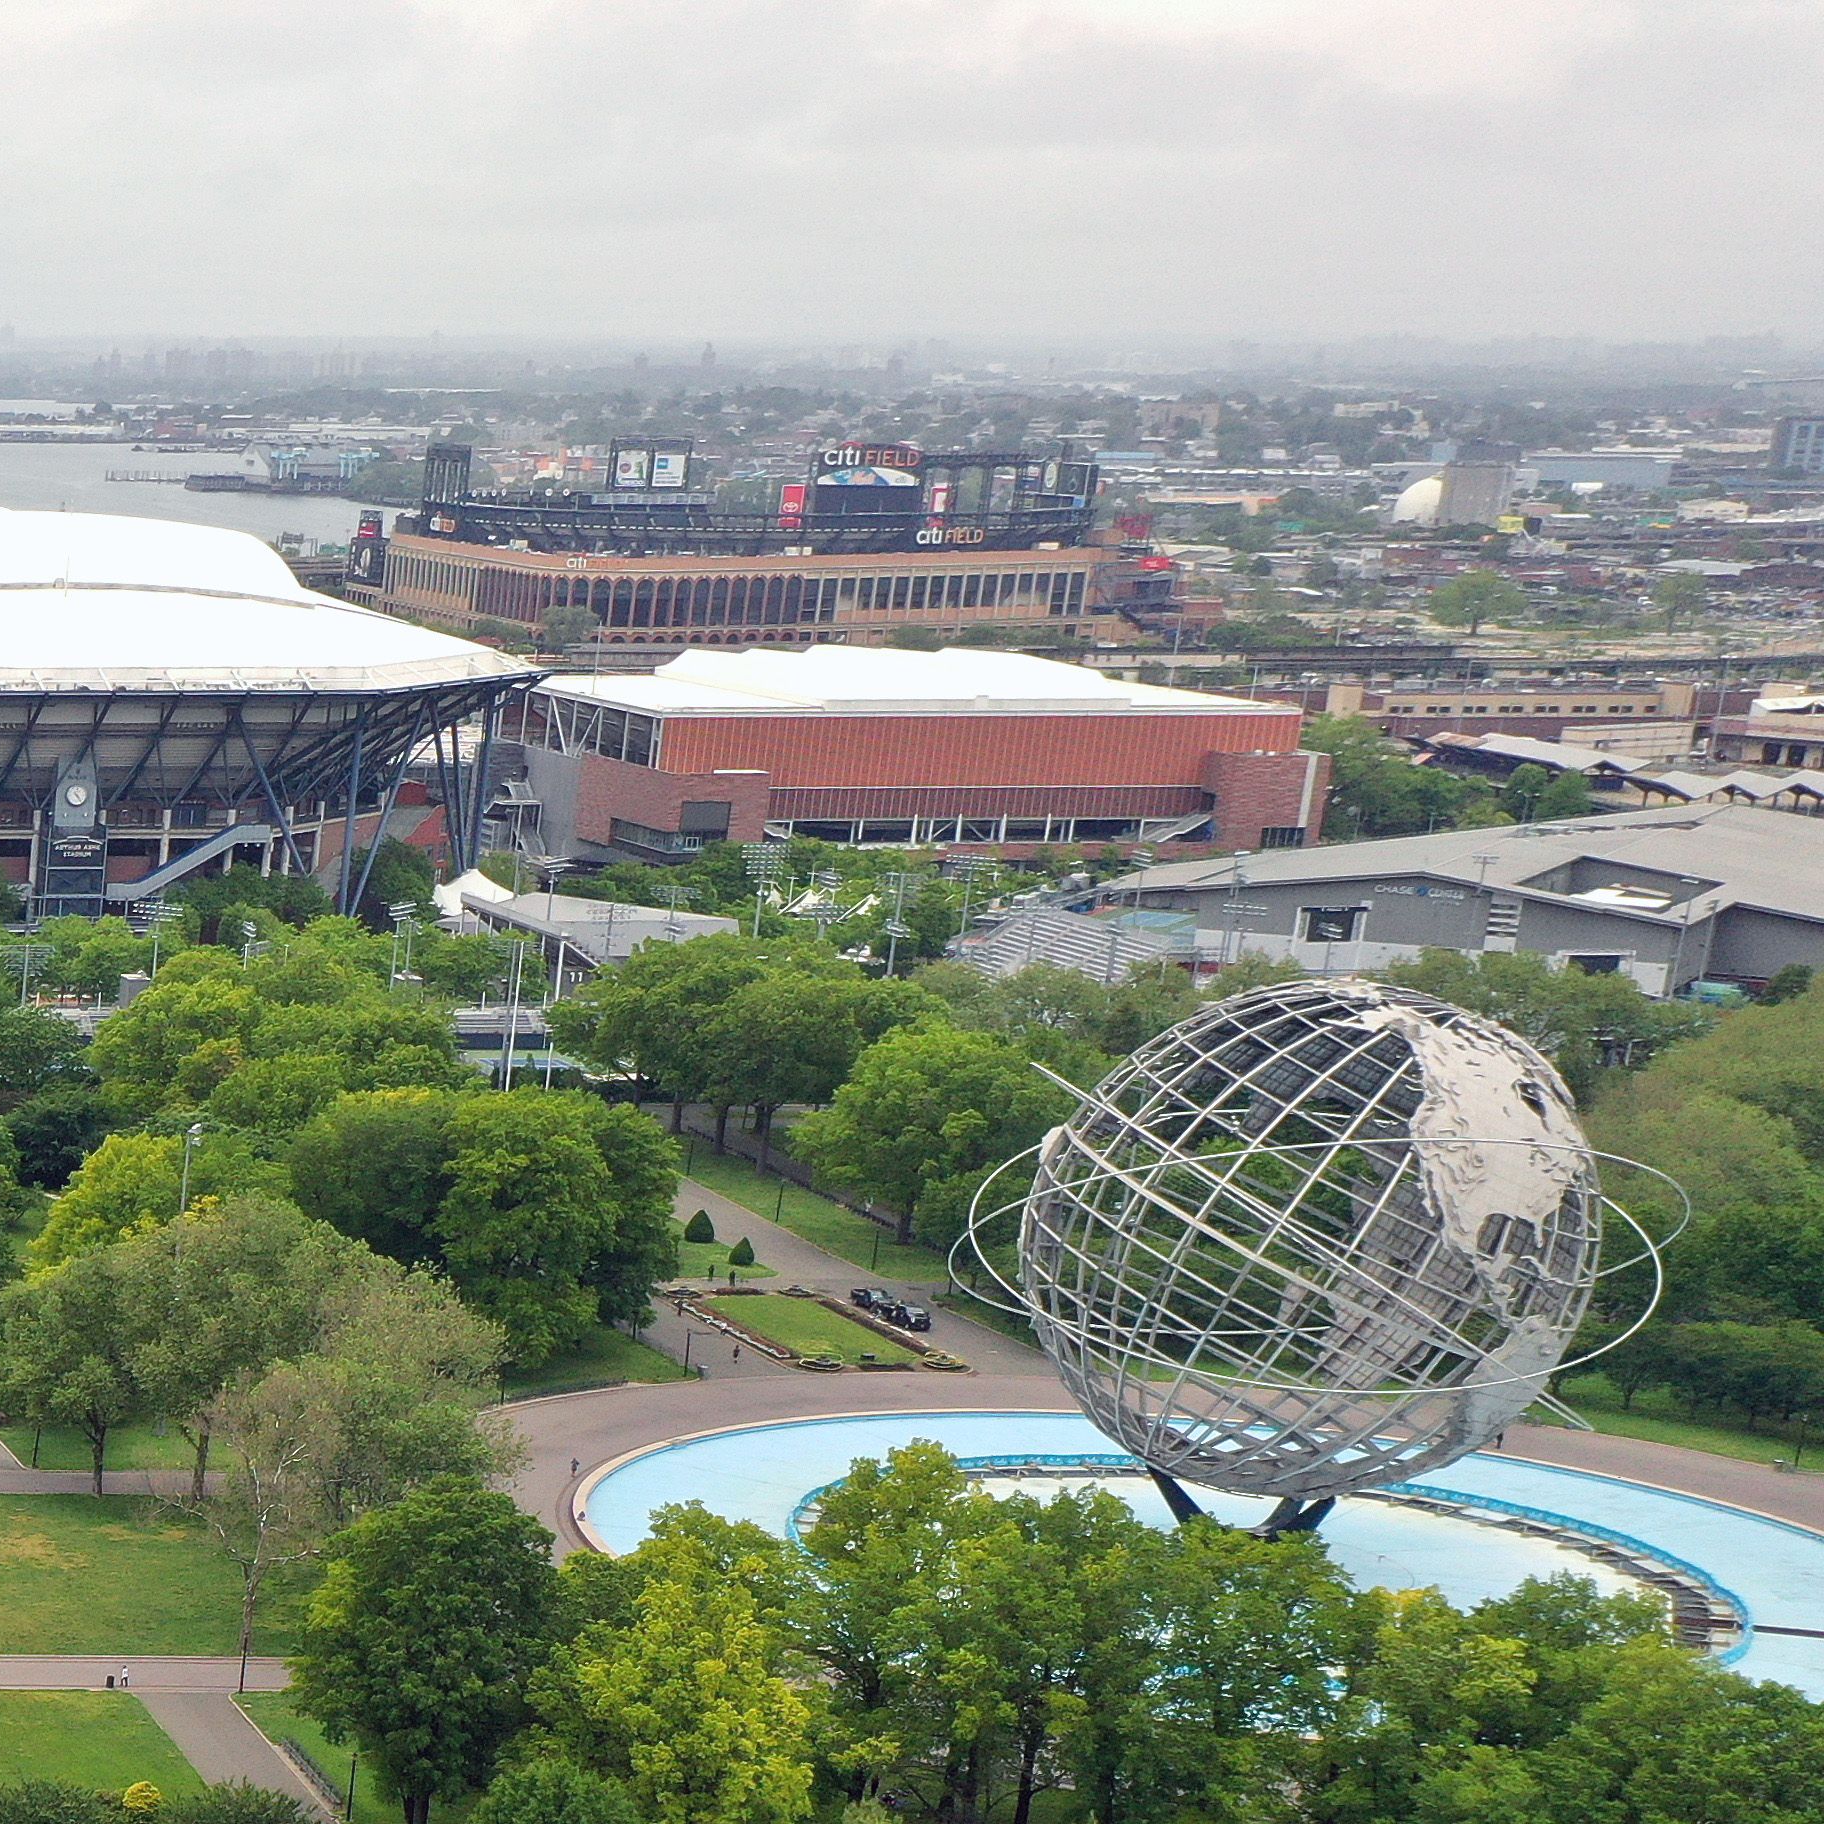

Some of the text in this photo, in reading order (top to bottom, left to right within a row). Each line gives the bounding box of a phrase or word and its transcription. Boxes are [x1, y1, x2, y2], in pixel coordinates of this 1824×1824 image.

[824, 446, 921, 467] citi FIELD
[916, 527, 984, 545] citi FIELD
[1374, 884, 1415, 895] CHASE
